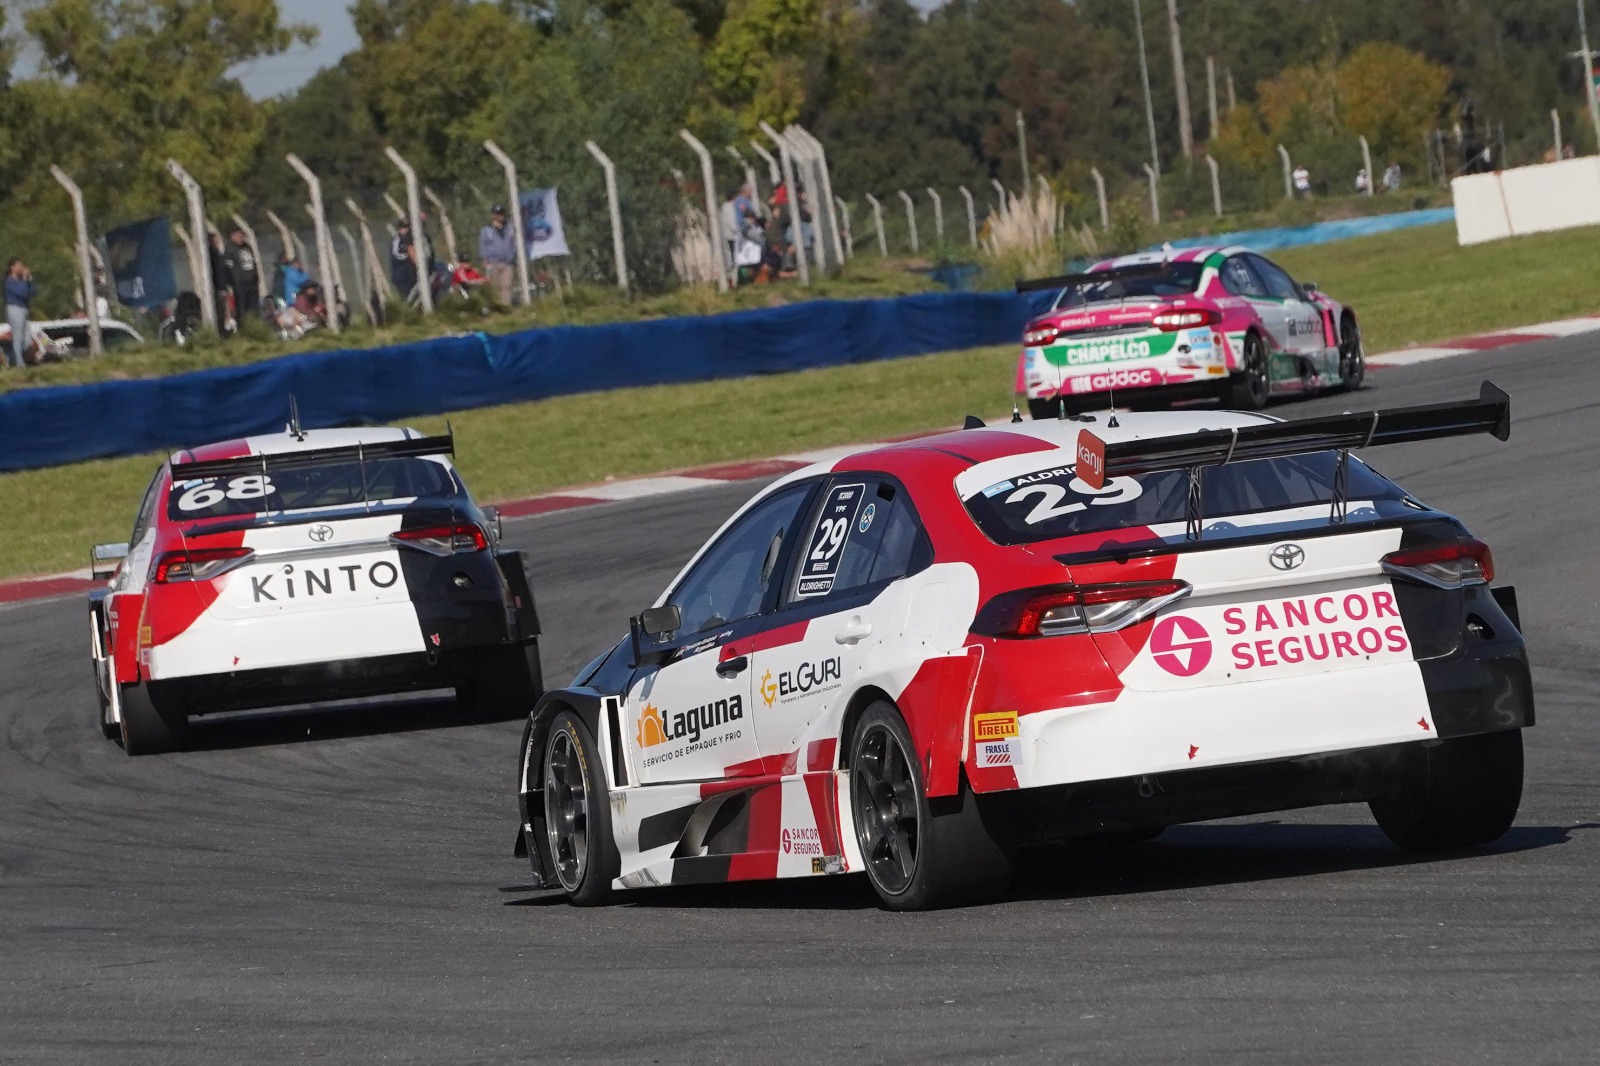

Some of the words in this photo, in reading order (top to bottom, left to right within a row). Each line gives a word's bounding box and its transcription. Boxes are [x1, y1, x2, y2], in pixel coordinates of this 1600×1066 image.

[1067, 341, 1150, 364] CHAPELCO
[1093, 371, 1152, 389] addoc
[1078, 443, 1102, 475] kanji
[178, 475, 276, 511] 68
[835, 505, 848, 513] YPF
[1004, 476, 1143, 525] 29
[810, 517, 848, 560] 29
[800, 580, 831, 591] ALDRIGHETTI
[1223, 591, 1400, 635] SANCOR
[1231, 625, 1408, 670] SEGUROS
[662, 694, 743, 743] Laguna
[977, 717, 1015, 736] PIRELLI
[643, 752, 673, 768] SERVICIO
[675, 748, 684, 759] DE
[685, 737, 717, 755] EMPAQUE
[725, 730, 742, 742] FRIO
[792, 828, 819, 840] SANCOR
[794, 843, 820, 855] SEGUROS
